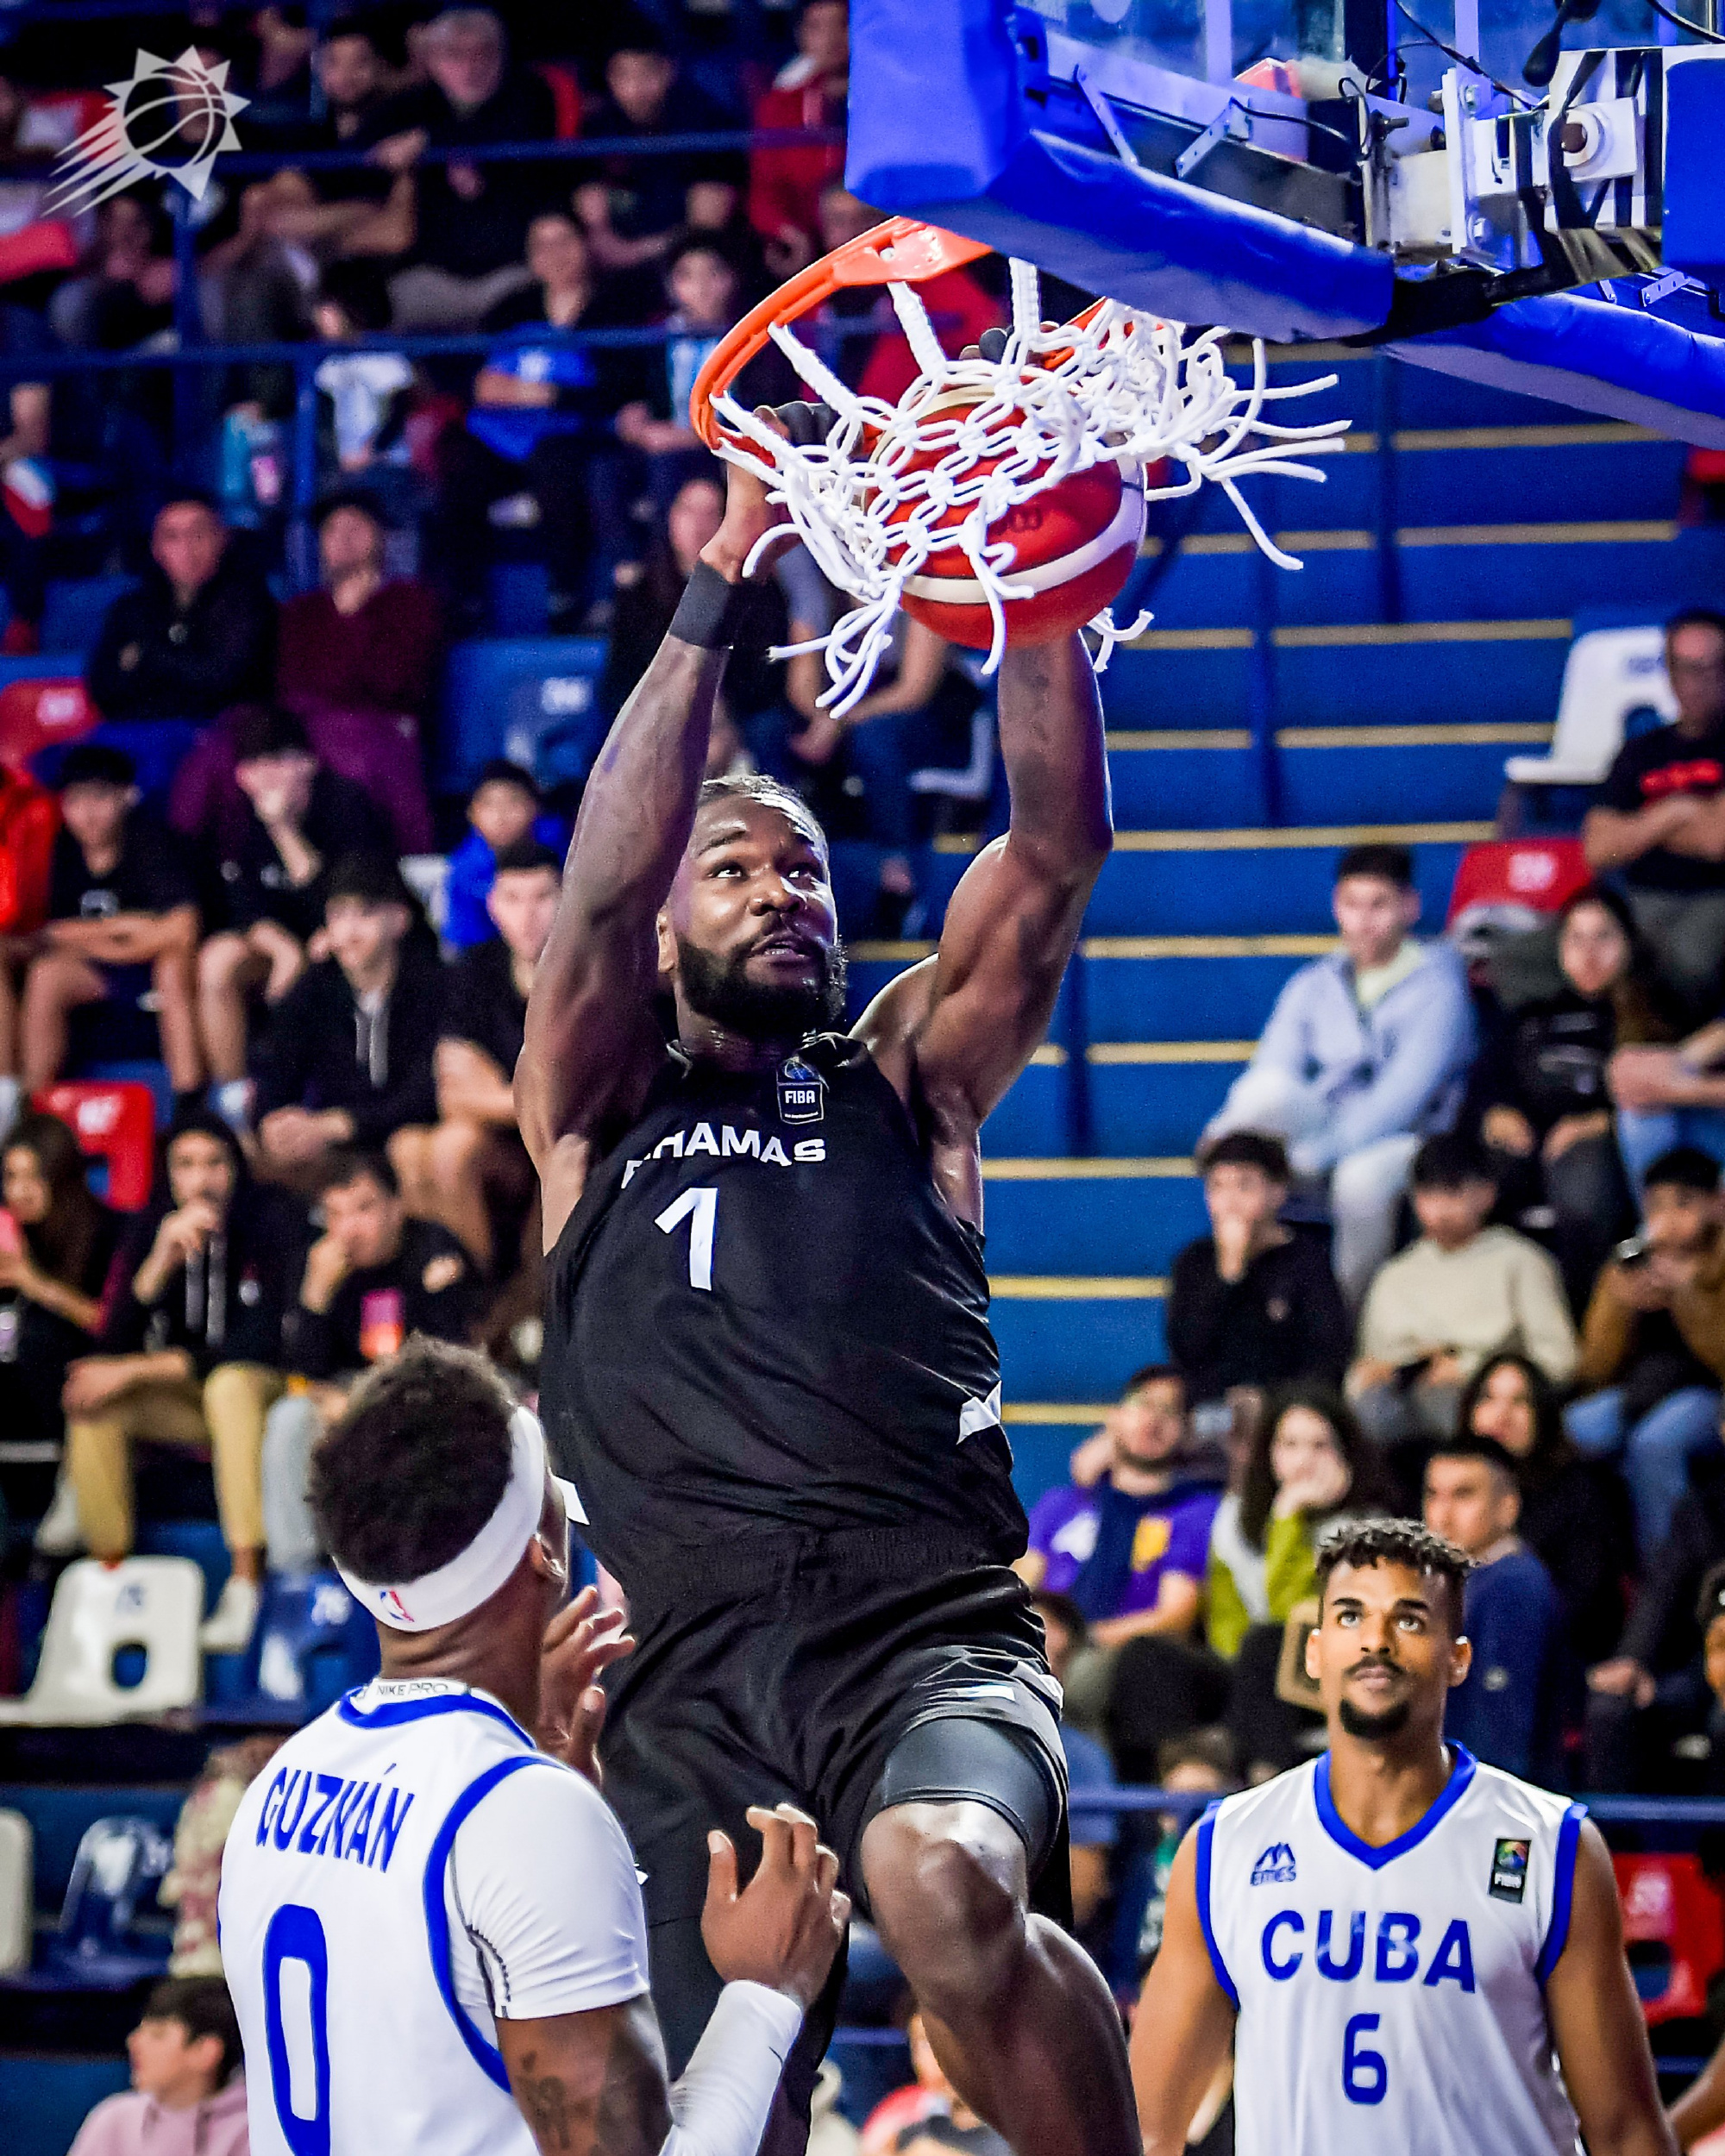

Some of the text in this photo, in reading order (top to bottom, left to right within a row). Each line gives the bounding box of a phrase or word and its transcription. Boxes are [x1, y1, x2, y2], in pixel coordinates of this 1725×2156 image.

[785, 1090, 815, 1104] FIBA
[621, 1123, 825, 1189] HAMAS
[655, 1188, 718, 1291] 1
[377, 1683, 448, 1696] NIKE PRO
[1261, 1909, 1476, 1994] CUBA
[262, 1903, 330, 2156] 0
[1343, 2013, 1387, 2104] 6
